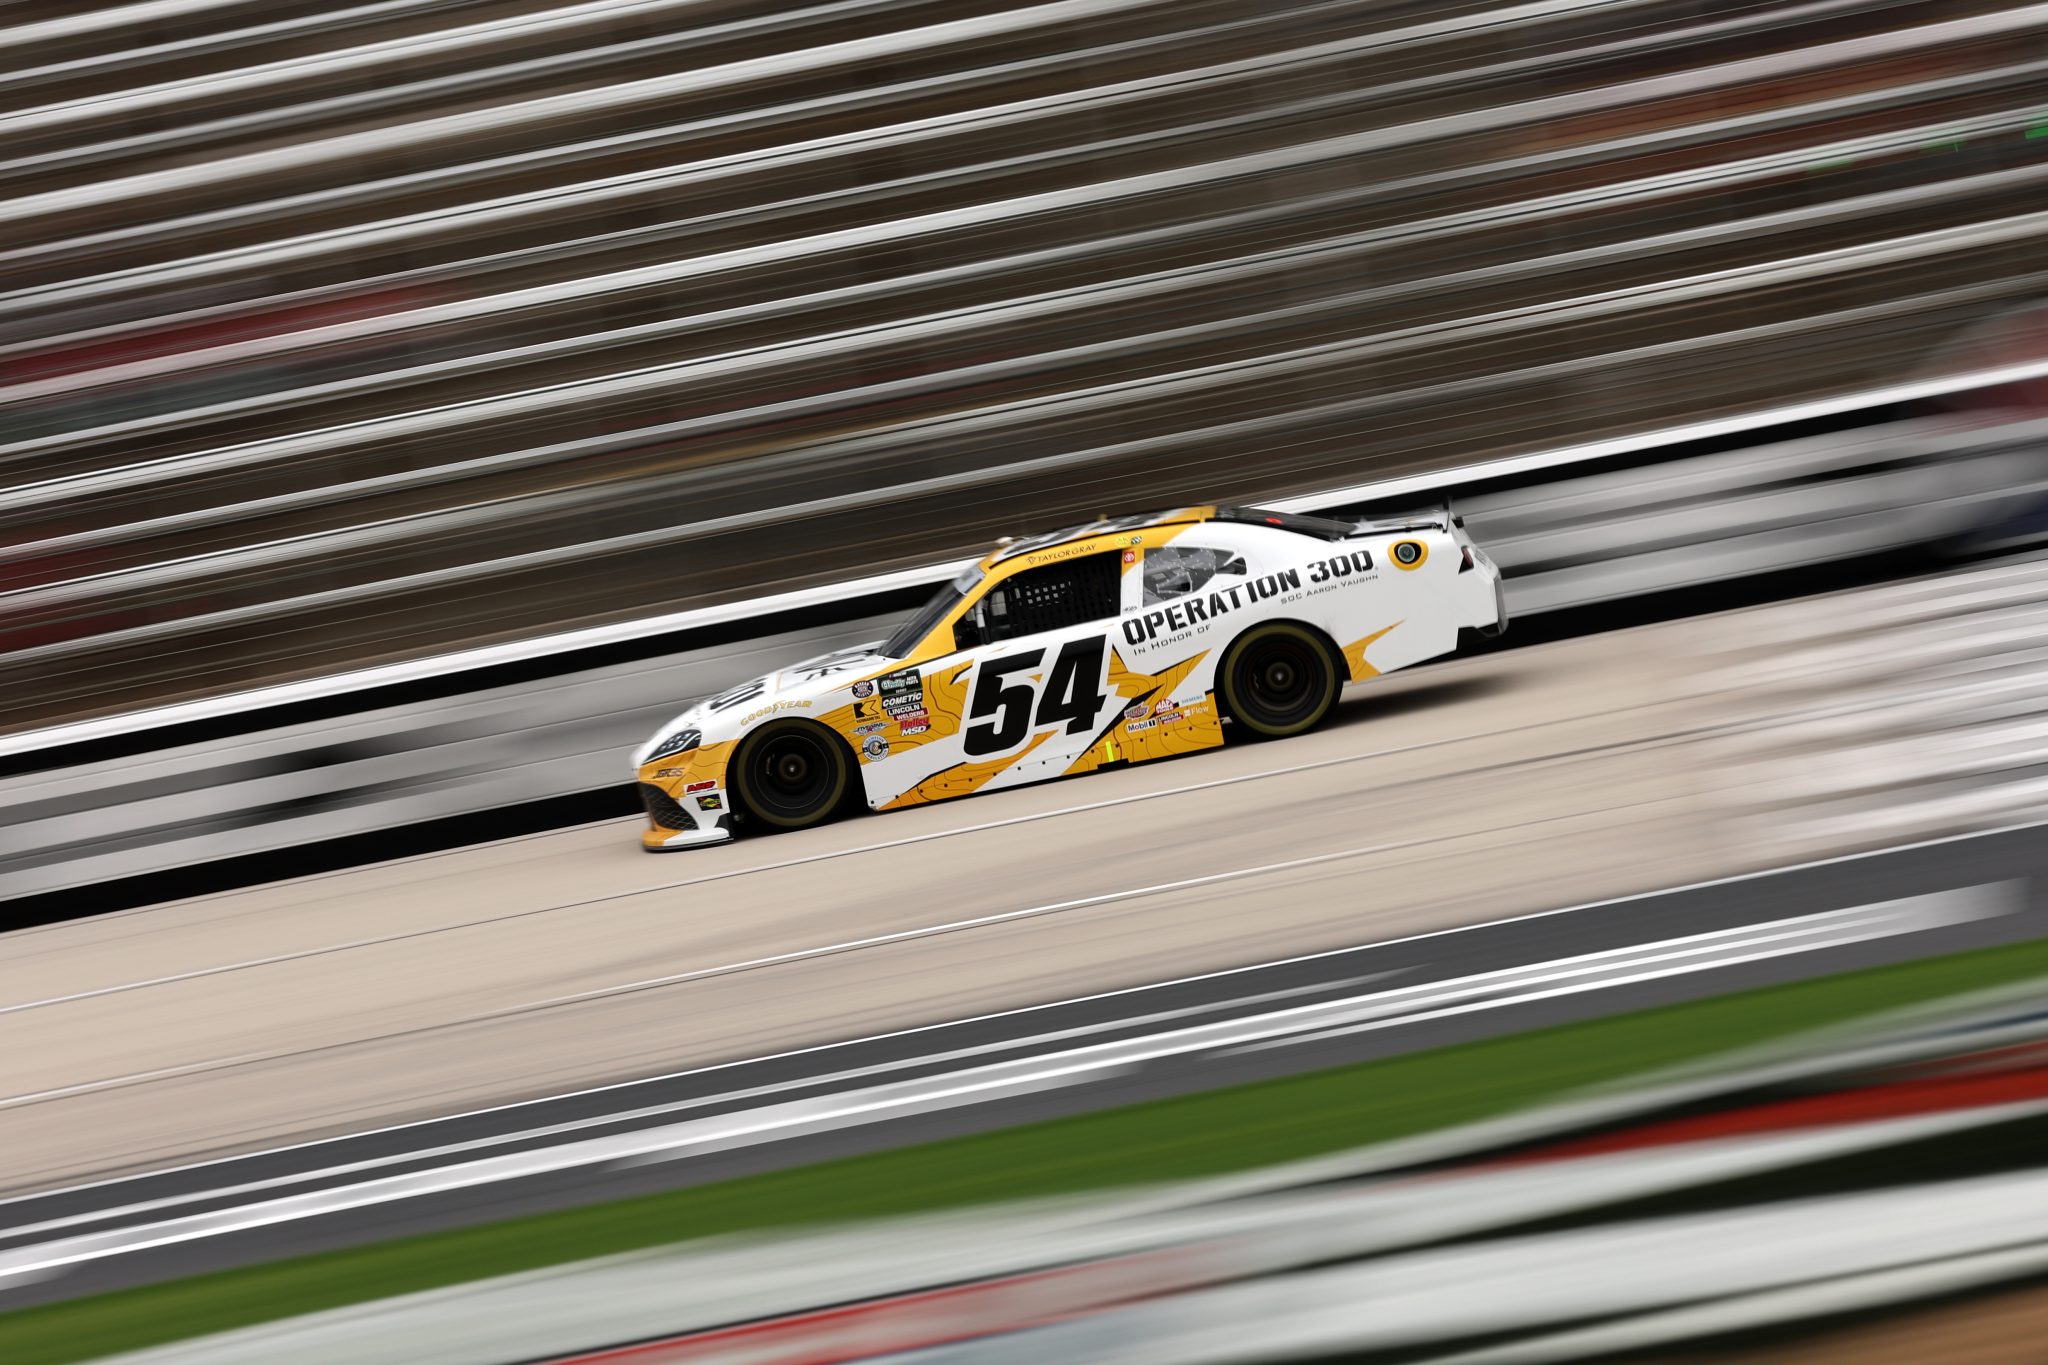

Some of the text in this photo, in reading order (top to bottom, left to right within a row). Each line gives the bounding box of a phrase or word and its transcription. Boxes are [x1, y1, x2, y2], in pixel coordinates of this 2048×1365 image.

[1037, 544, 1097, 563] TAYLOR GRAY
[1306, 584, 1337, 597] AARON
[1340, 574, 1378, 587] VAUGHN
[1122, 550, 1374, 646] OPERATION 300
[1133, 624, 1211, 656] IN HONOR OF
[882, 692, 922, 708] COMETIC
[963, 634, 1107, 757] 54
[740, 700, 813, 727] GOODYEAR
[888, 704, 920, 716] LINCOLN
[896, 710, 925, 720] WELDERS
[1191, 705, 1209, 715] Flow
[901, 725, 927, 737] MSD
[1127, 723, 1149, 732] Mobil
